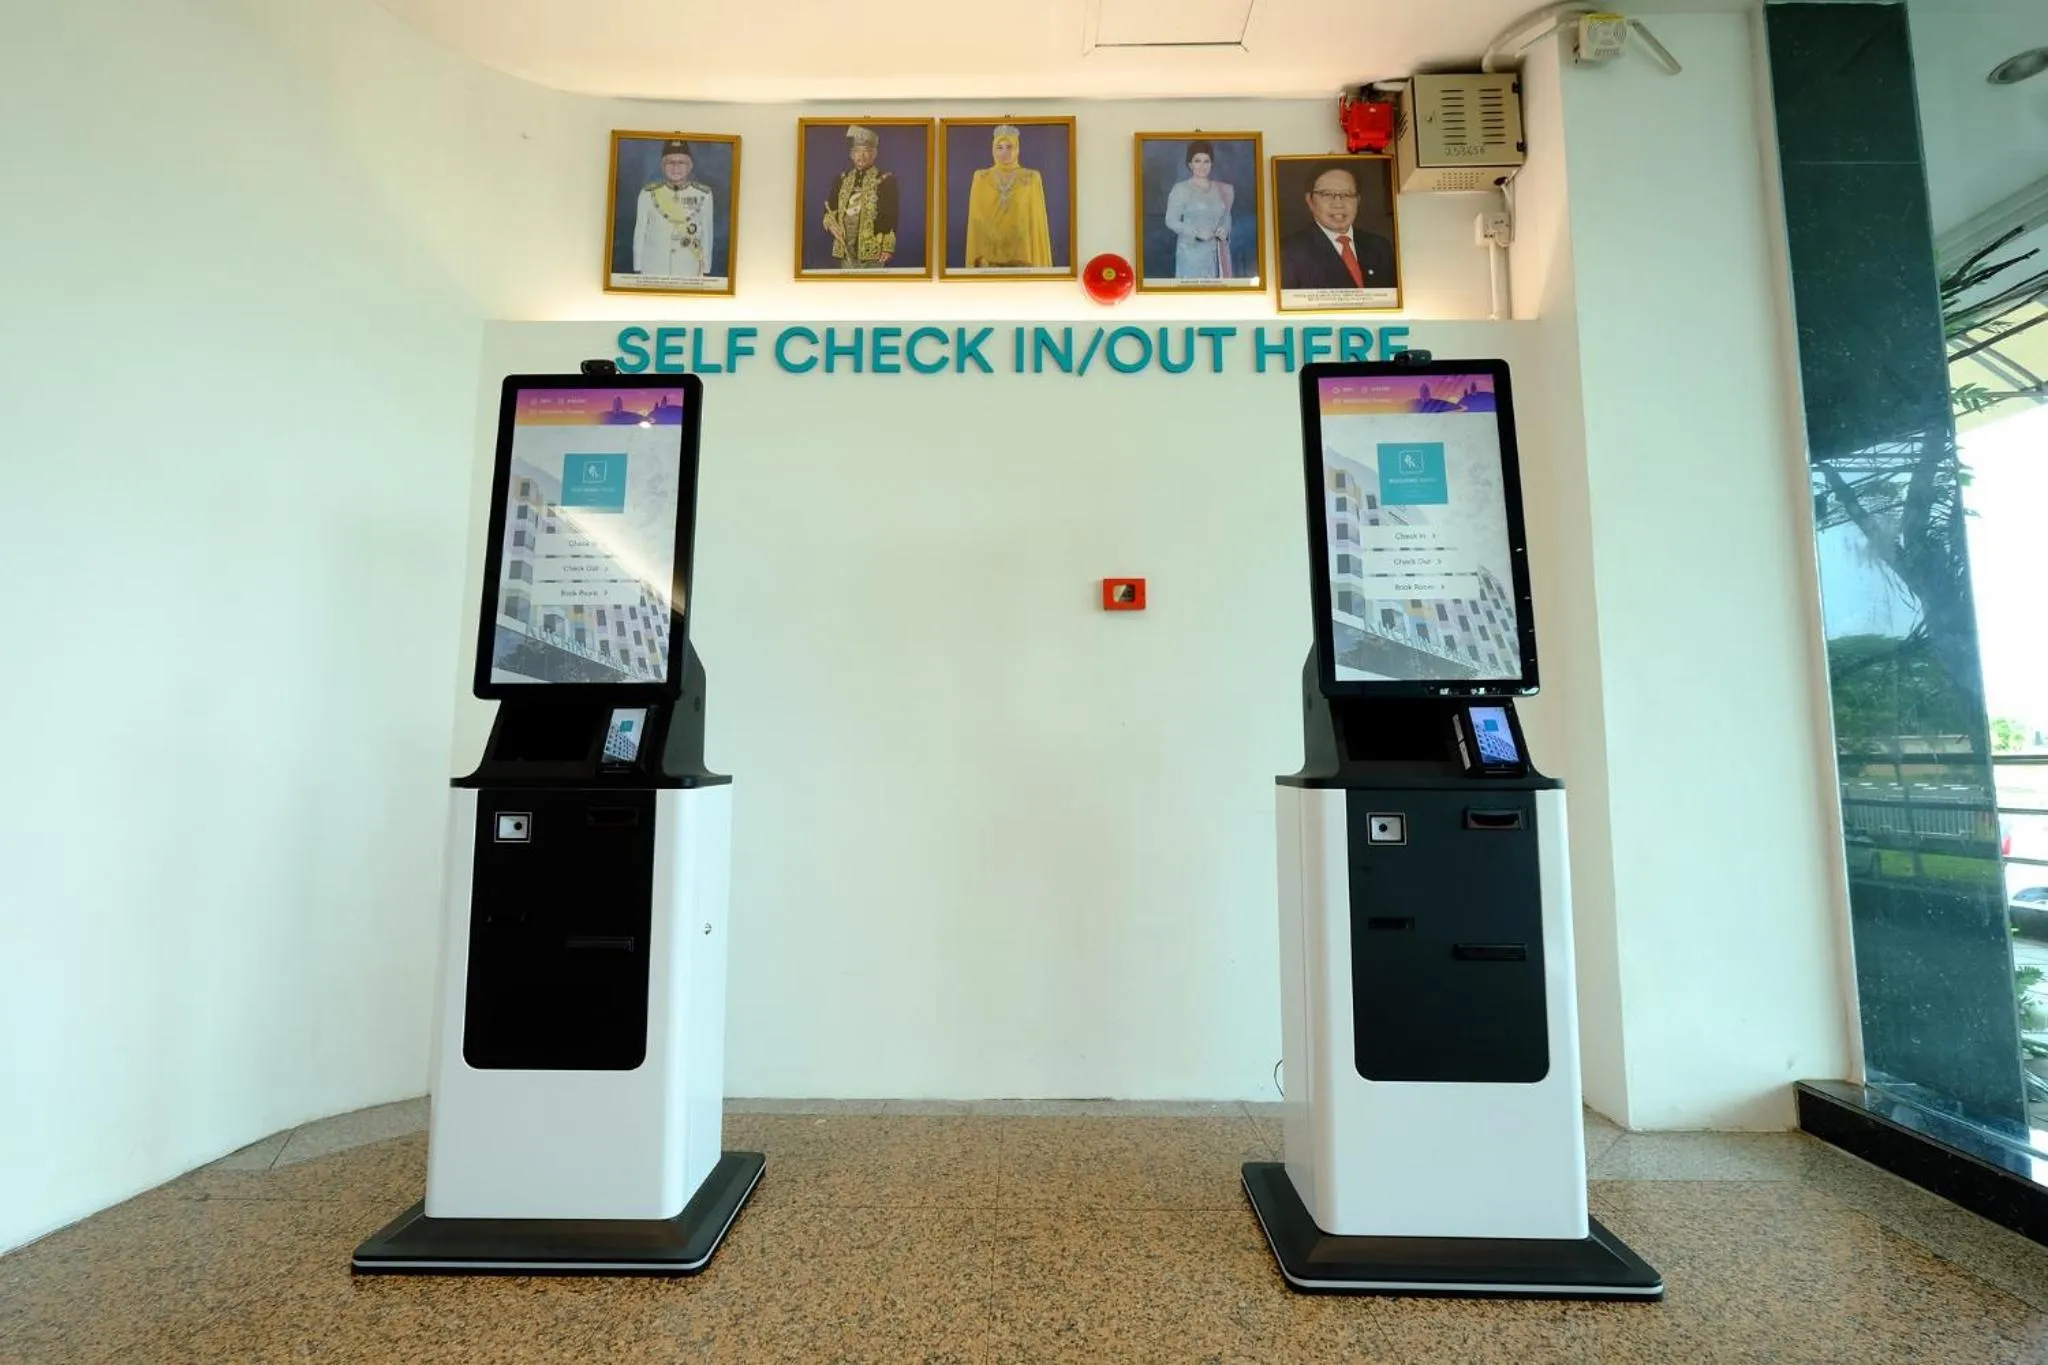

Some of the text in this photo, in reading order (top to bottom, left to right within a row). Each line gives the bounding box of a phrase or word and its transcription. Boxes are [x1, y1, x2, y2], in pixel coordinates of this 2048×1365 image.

[616, 325, 1410, 374] SELF CHECK IN/OUT HERE
